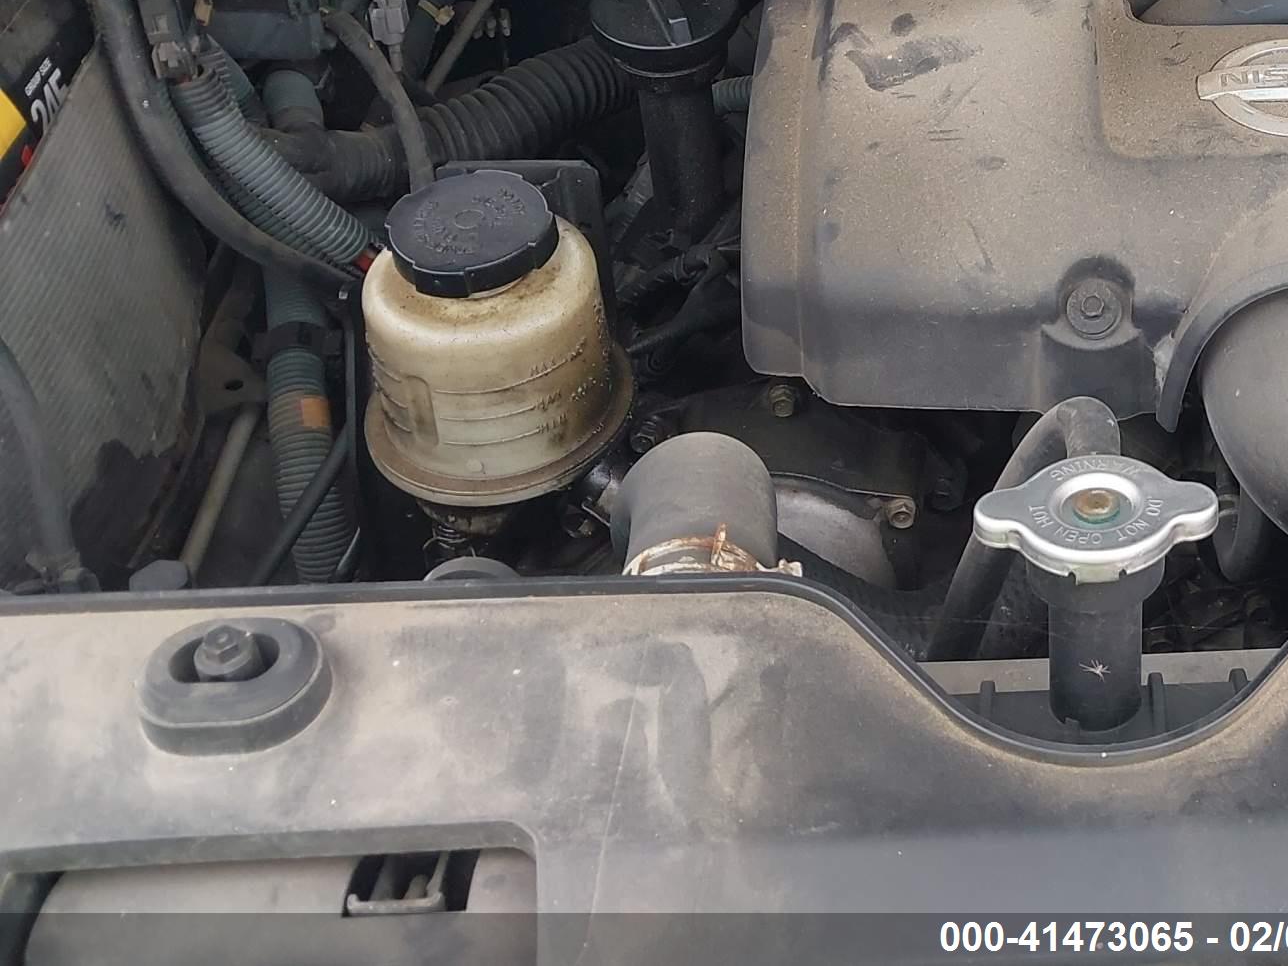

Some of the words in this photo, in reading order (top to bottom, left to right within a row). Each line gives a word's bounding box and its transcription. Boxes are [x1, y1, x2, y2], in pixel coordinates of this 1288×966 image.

[1028, 504, 1051, 528] HOT
[1055, 527, 1103, 545] OPEN
[1116, 520, 1150, 541] NOT
